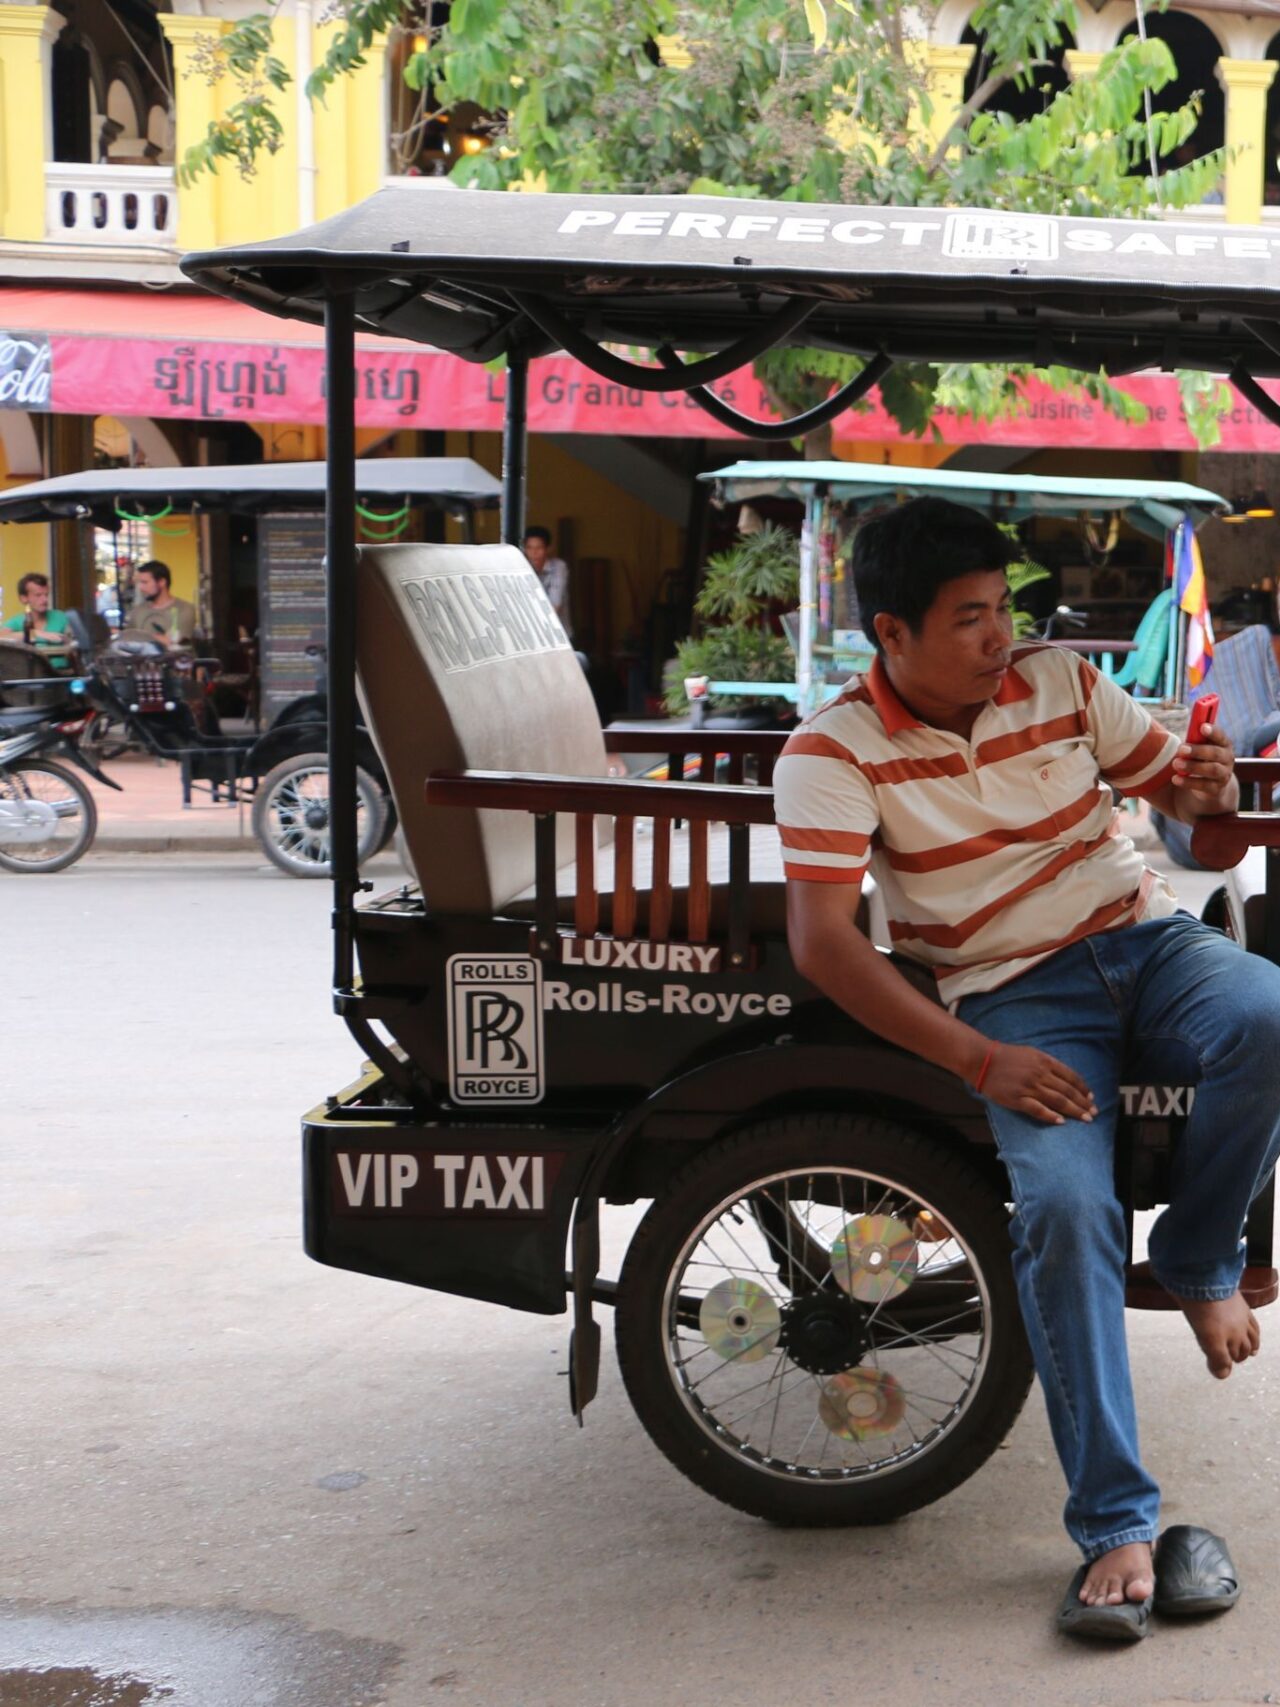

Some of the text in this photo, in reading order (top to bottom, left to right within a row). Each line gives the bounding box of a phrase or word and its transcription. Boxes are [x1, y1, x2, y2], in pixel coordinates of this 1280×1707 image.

[557, 209, 941, 246] PERFECT
[403, 574, 567, 670] ROLLS-ROYCE
[461, 964, 528, 979] ROLLS
[561, 937, 719, 973] LUXURY
[544, 981, 792, 1022] Rolls-Royce
[463, 1080, 530, 1094] ROYCE
[1119, 1086, 1196, 1116] TAXI
[337, 1153, 544, 1209] VIP TAXI
